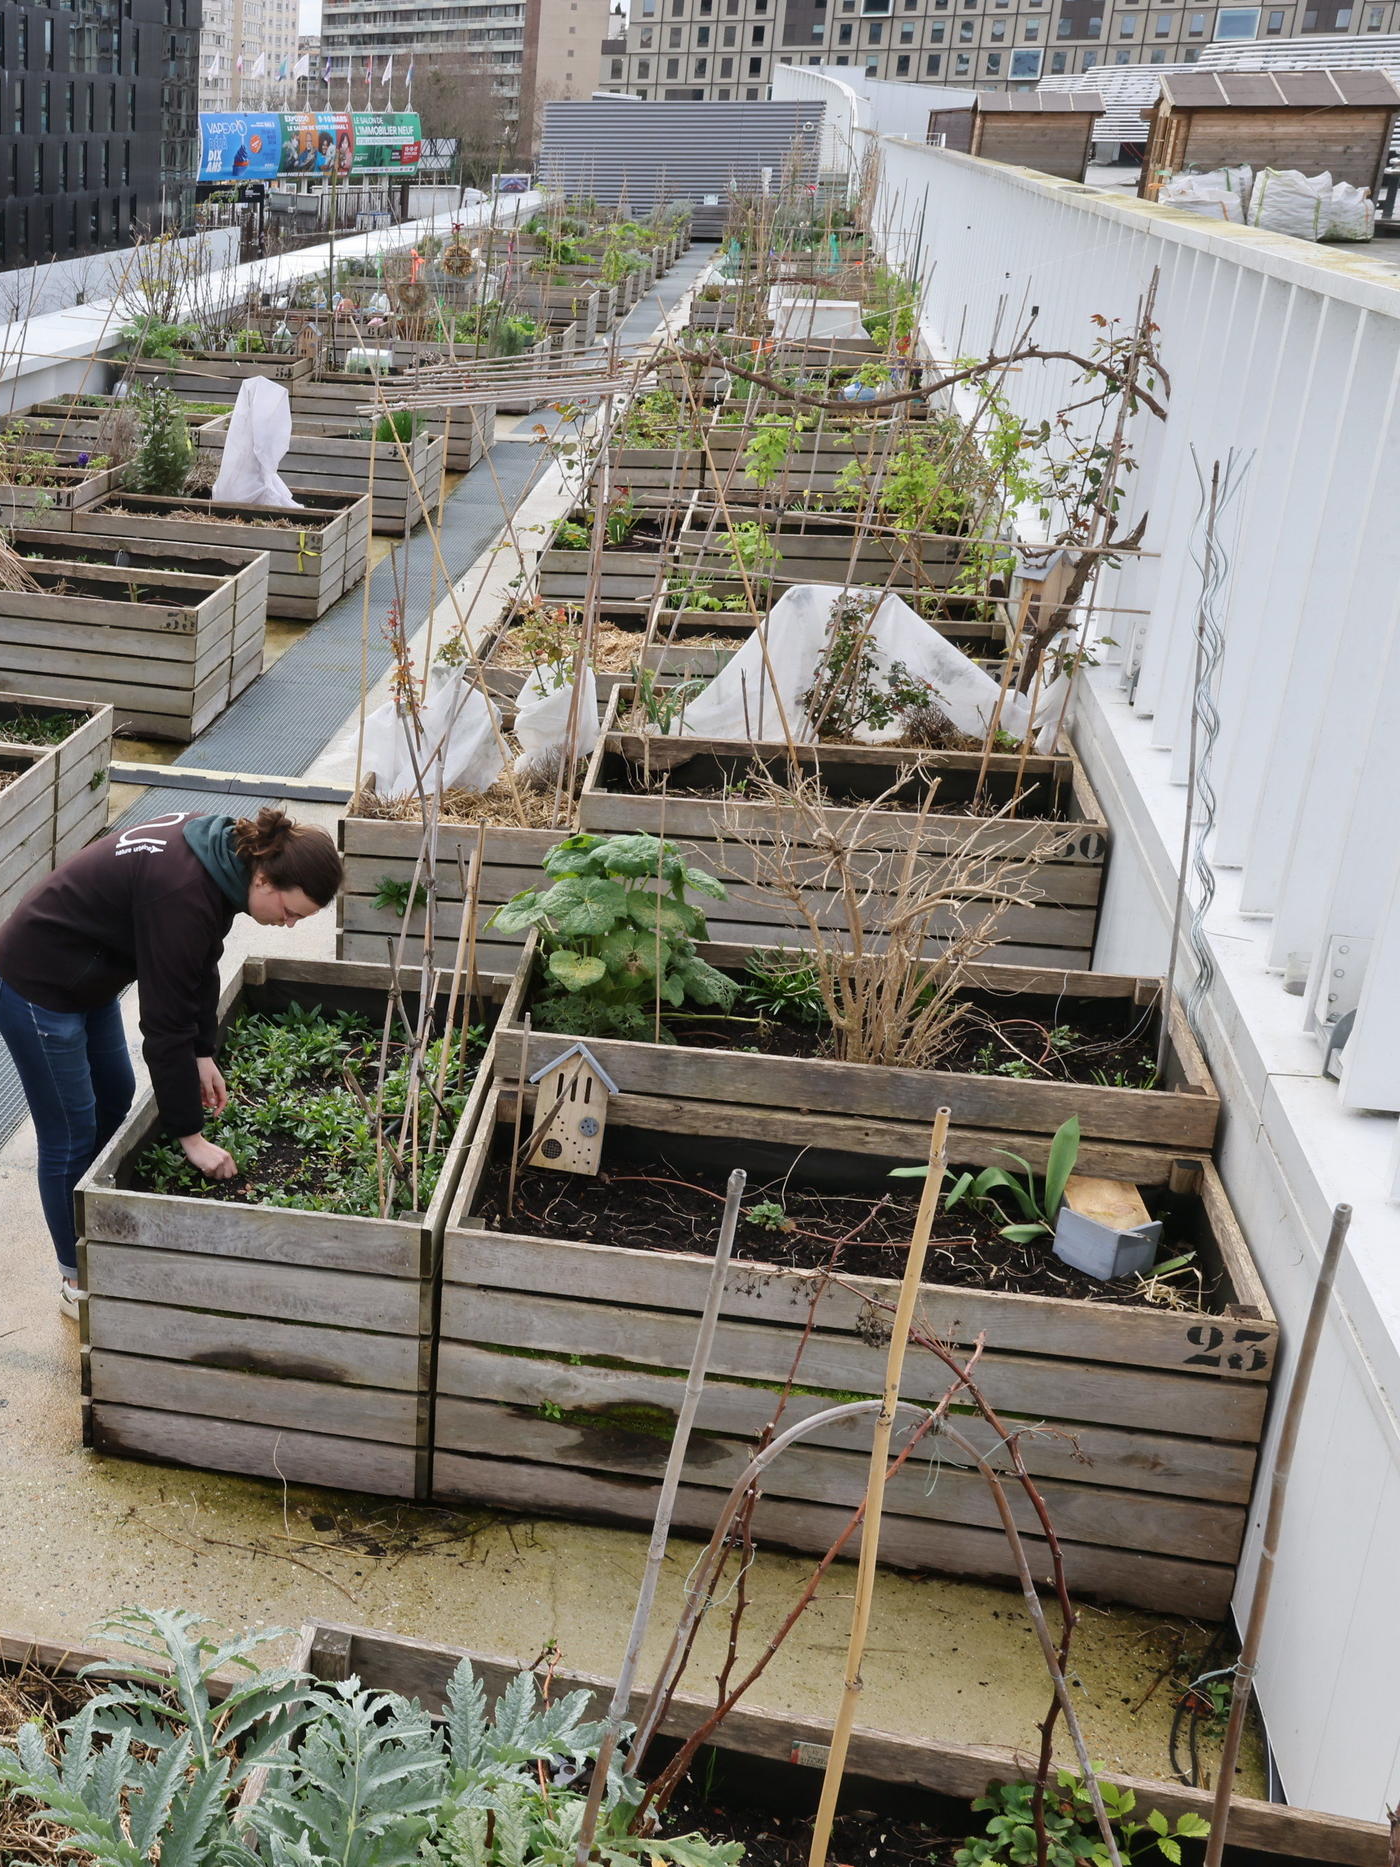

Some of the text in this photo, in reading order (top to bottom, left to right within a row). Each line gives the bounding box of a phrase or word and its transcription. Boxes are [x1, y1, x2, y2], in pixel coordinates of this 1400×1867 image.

[355, 126, 414, 135] L'IMMOBILIER NEUF
[208, 150, 222, 161] DIX
[205, 161, 222, 173] ANS
[115, 848, 132, 856] nature
